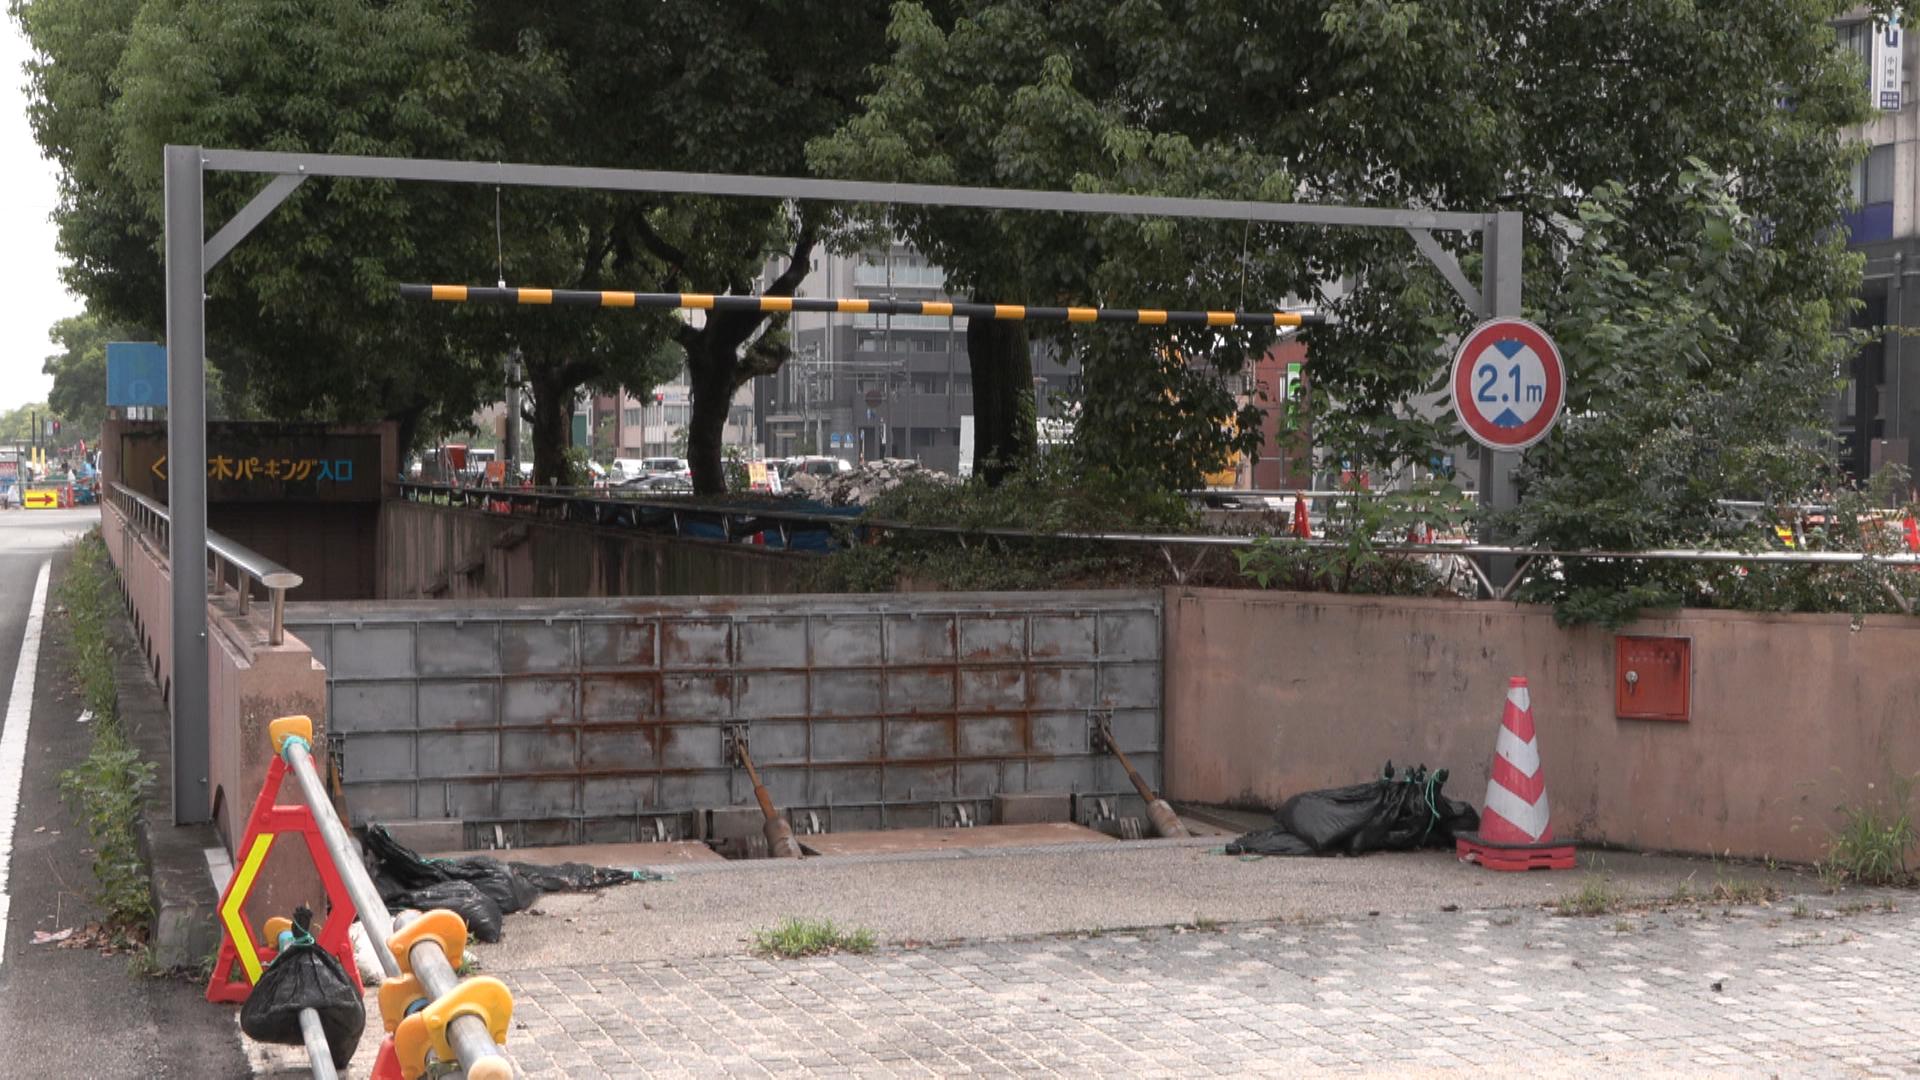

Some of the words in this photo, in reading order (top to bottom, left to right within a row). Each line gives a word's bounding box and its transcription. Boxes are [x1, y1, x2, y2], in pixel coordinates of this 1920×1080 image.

[1477, 363, 1542, 403] 2.1m
[152, 454, 353, 481] く木パーキング入口
